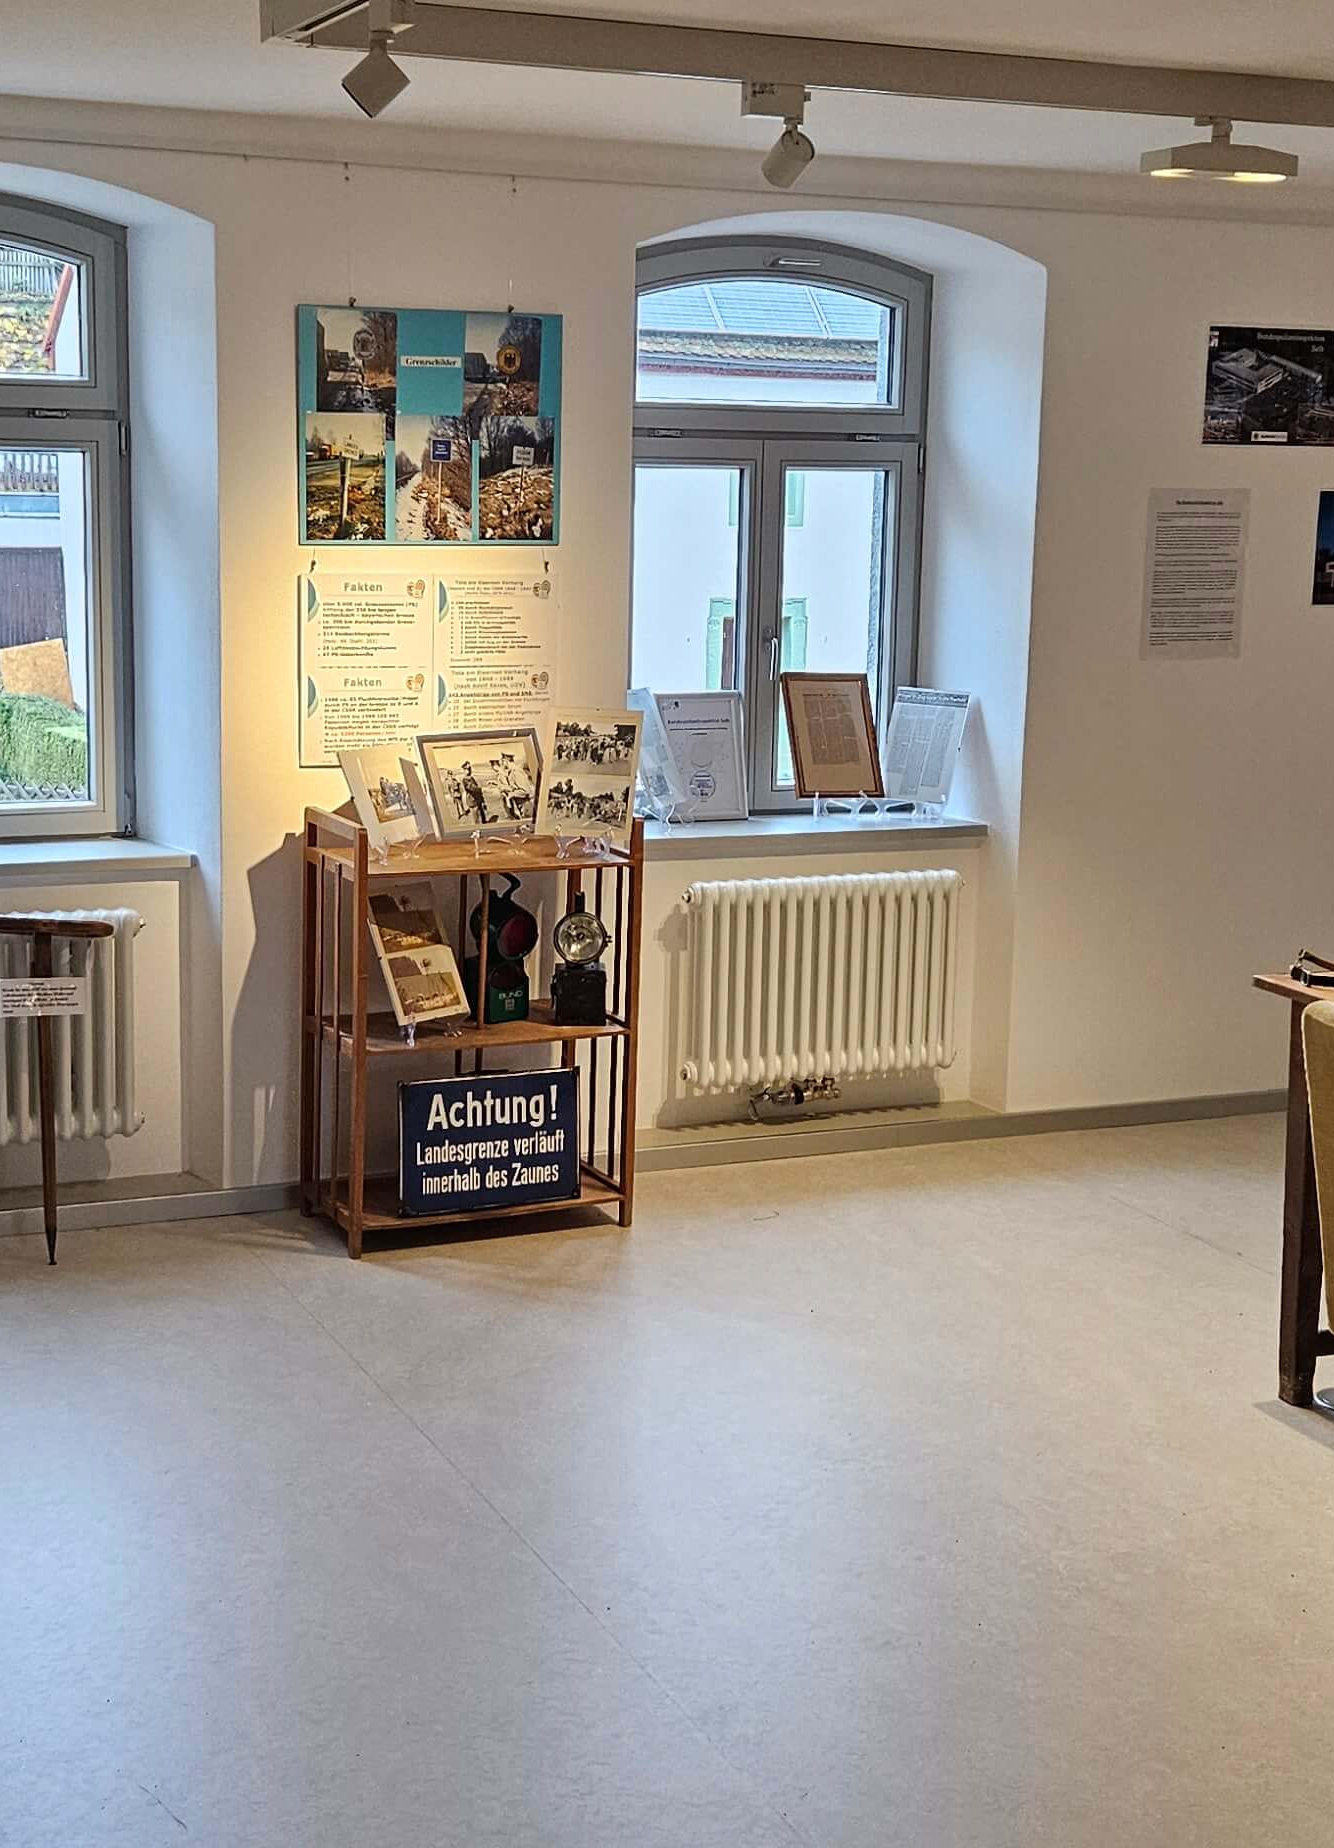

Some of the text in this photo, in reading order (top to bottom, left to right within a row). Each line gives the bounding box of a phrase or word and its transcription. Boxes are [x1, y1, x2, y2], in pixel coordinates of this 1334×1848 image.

[343, 581, 384, 592] Fakten
[343, 677, 382, 688] Fakten
[416, 1129, 566, 1166] Landesgrenze verläuft
[422, 1162, 560, 1196] innerhalb des Zaunes
